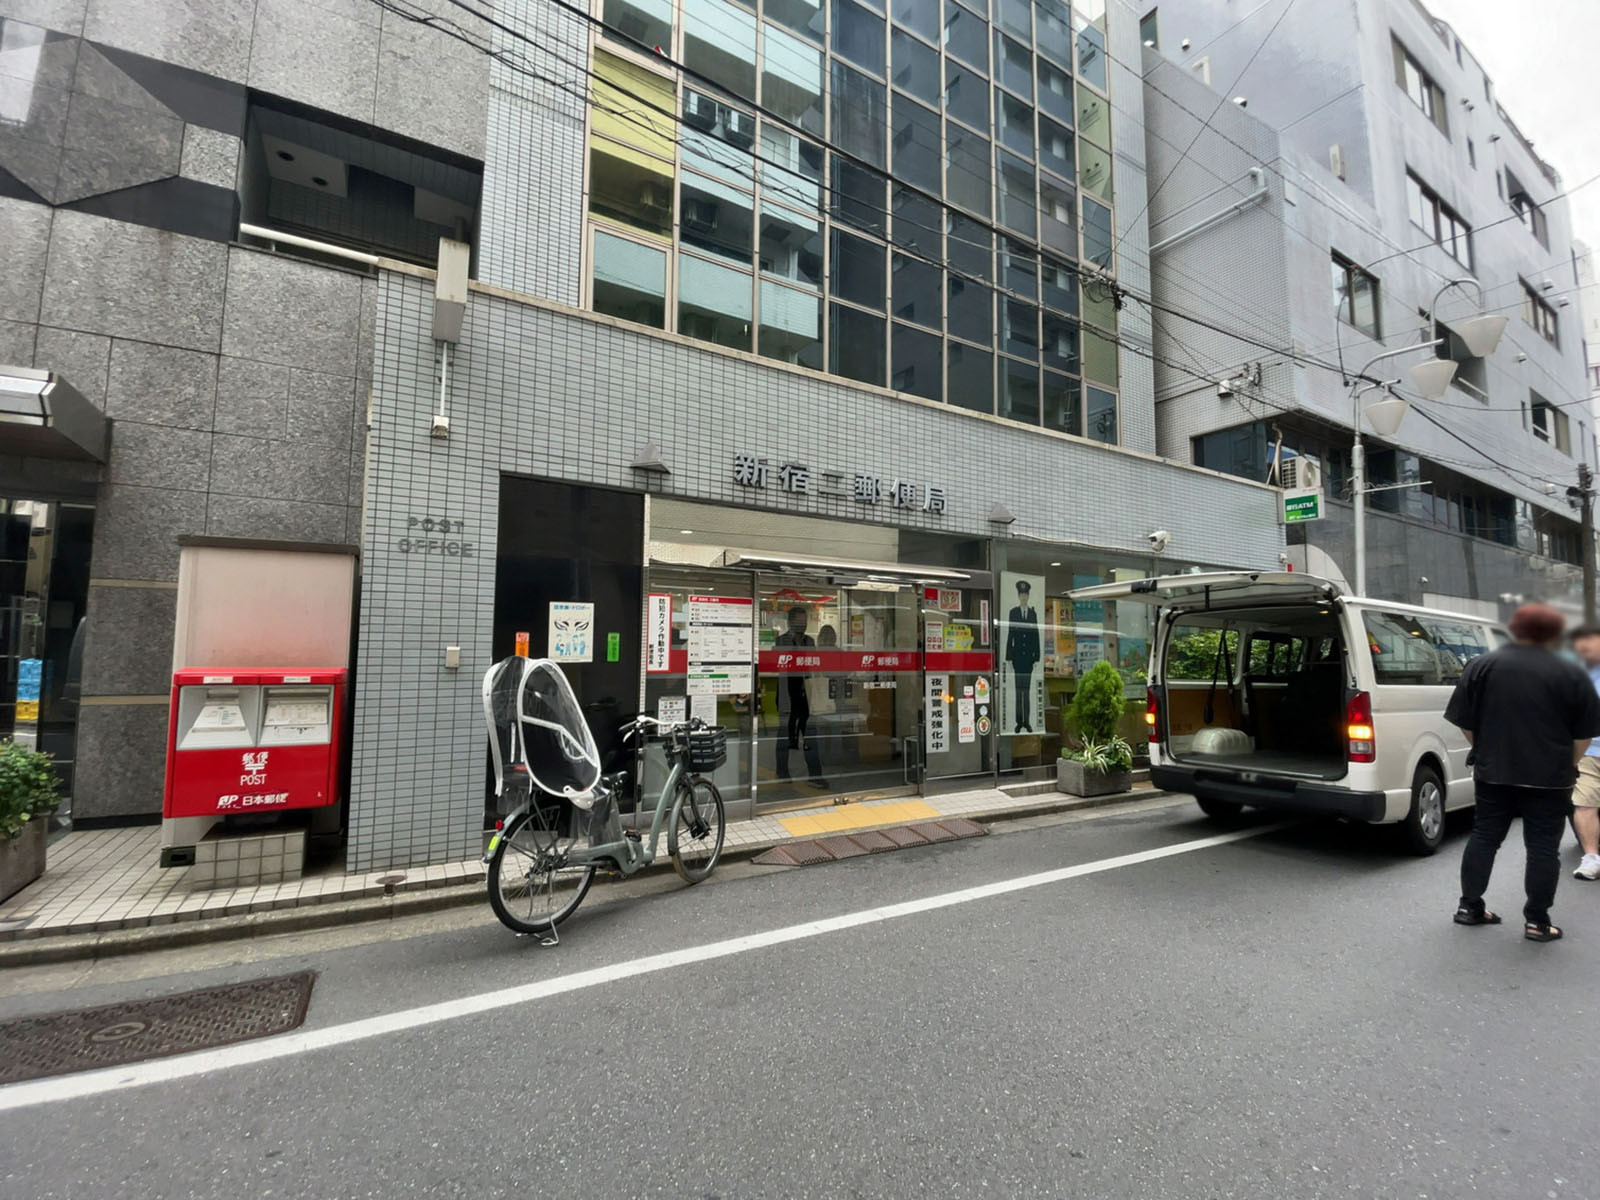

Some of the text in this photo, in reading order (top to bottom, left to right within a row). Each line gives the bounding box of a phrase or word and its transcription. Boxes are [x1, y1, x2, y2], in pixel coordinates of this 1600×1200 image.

[735, 452, 947, 515] 新宿二郵便局
[407, 517, 465, 534] POST
[398, 539, 473, 557] OFFICE
[796, 656, 821, 667] 郵便局
[877, 656, 899, 667] 郵便局
[931, 677, 944, 750] 夜間警戒強化中
[241, 751, 270, 766] 郵便
[240, 773, 267, 786] POST
[242, 792, 289, 807] 日本郵便
